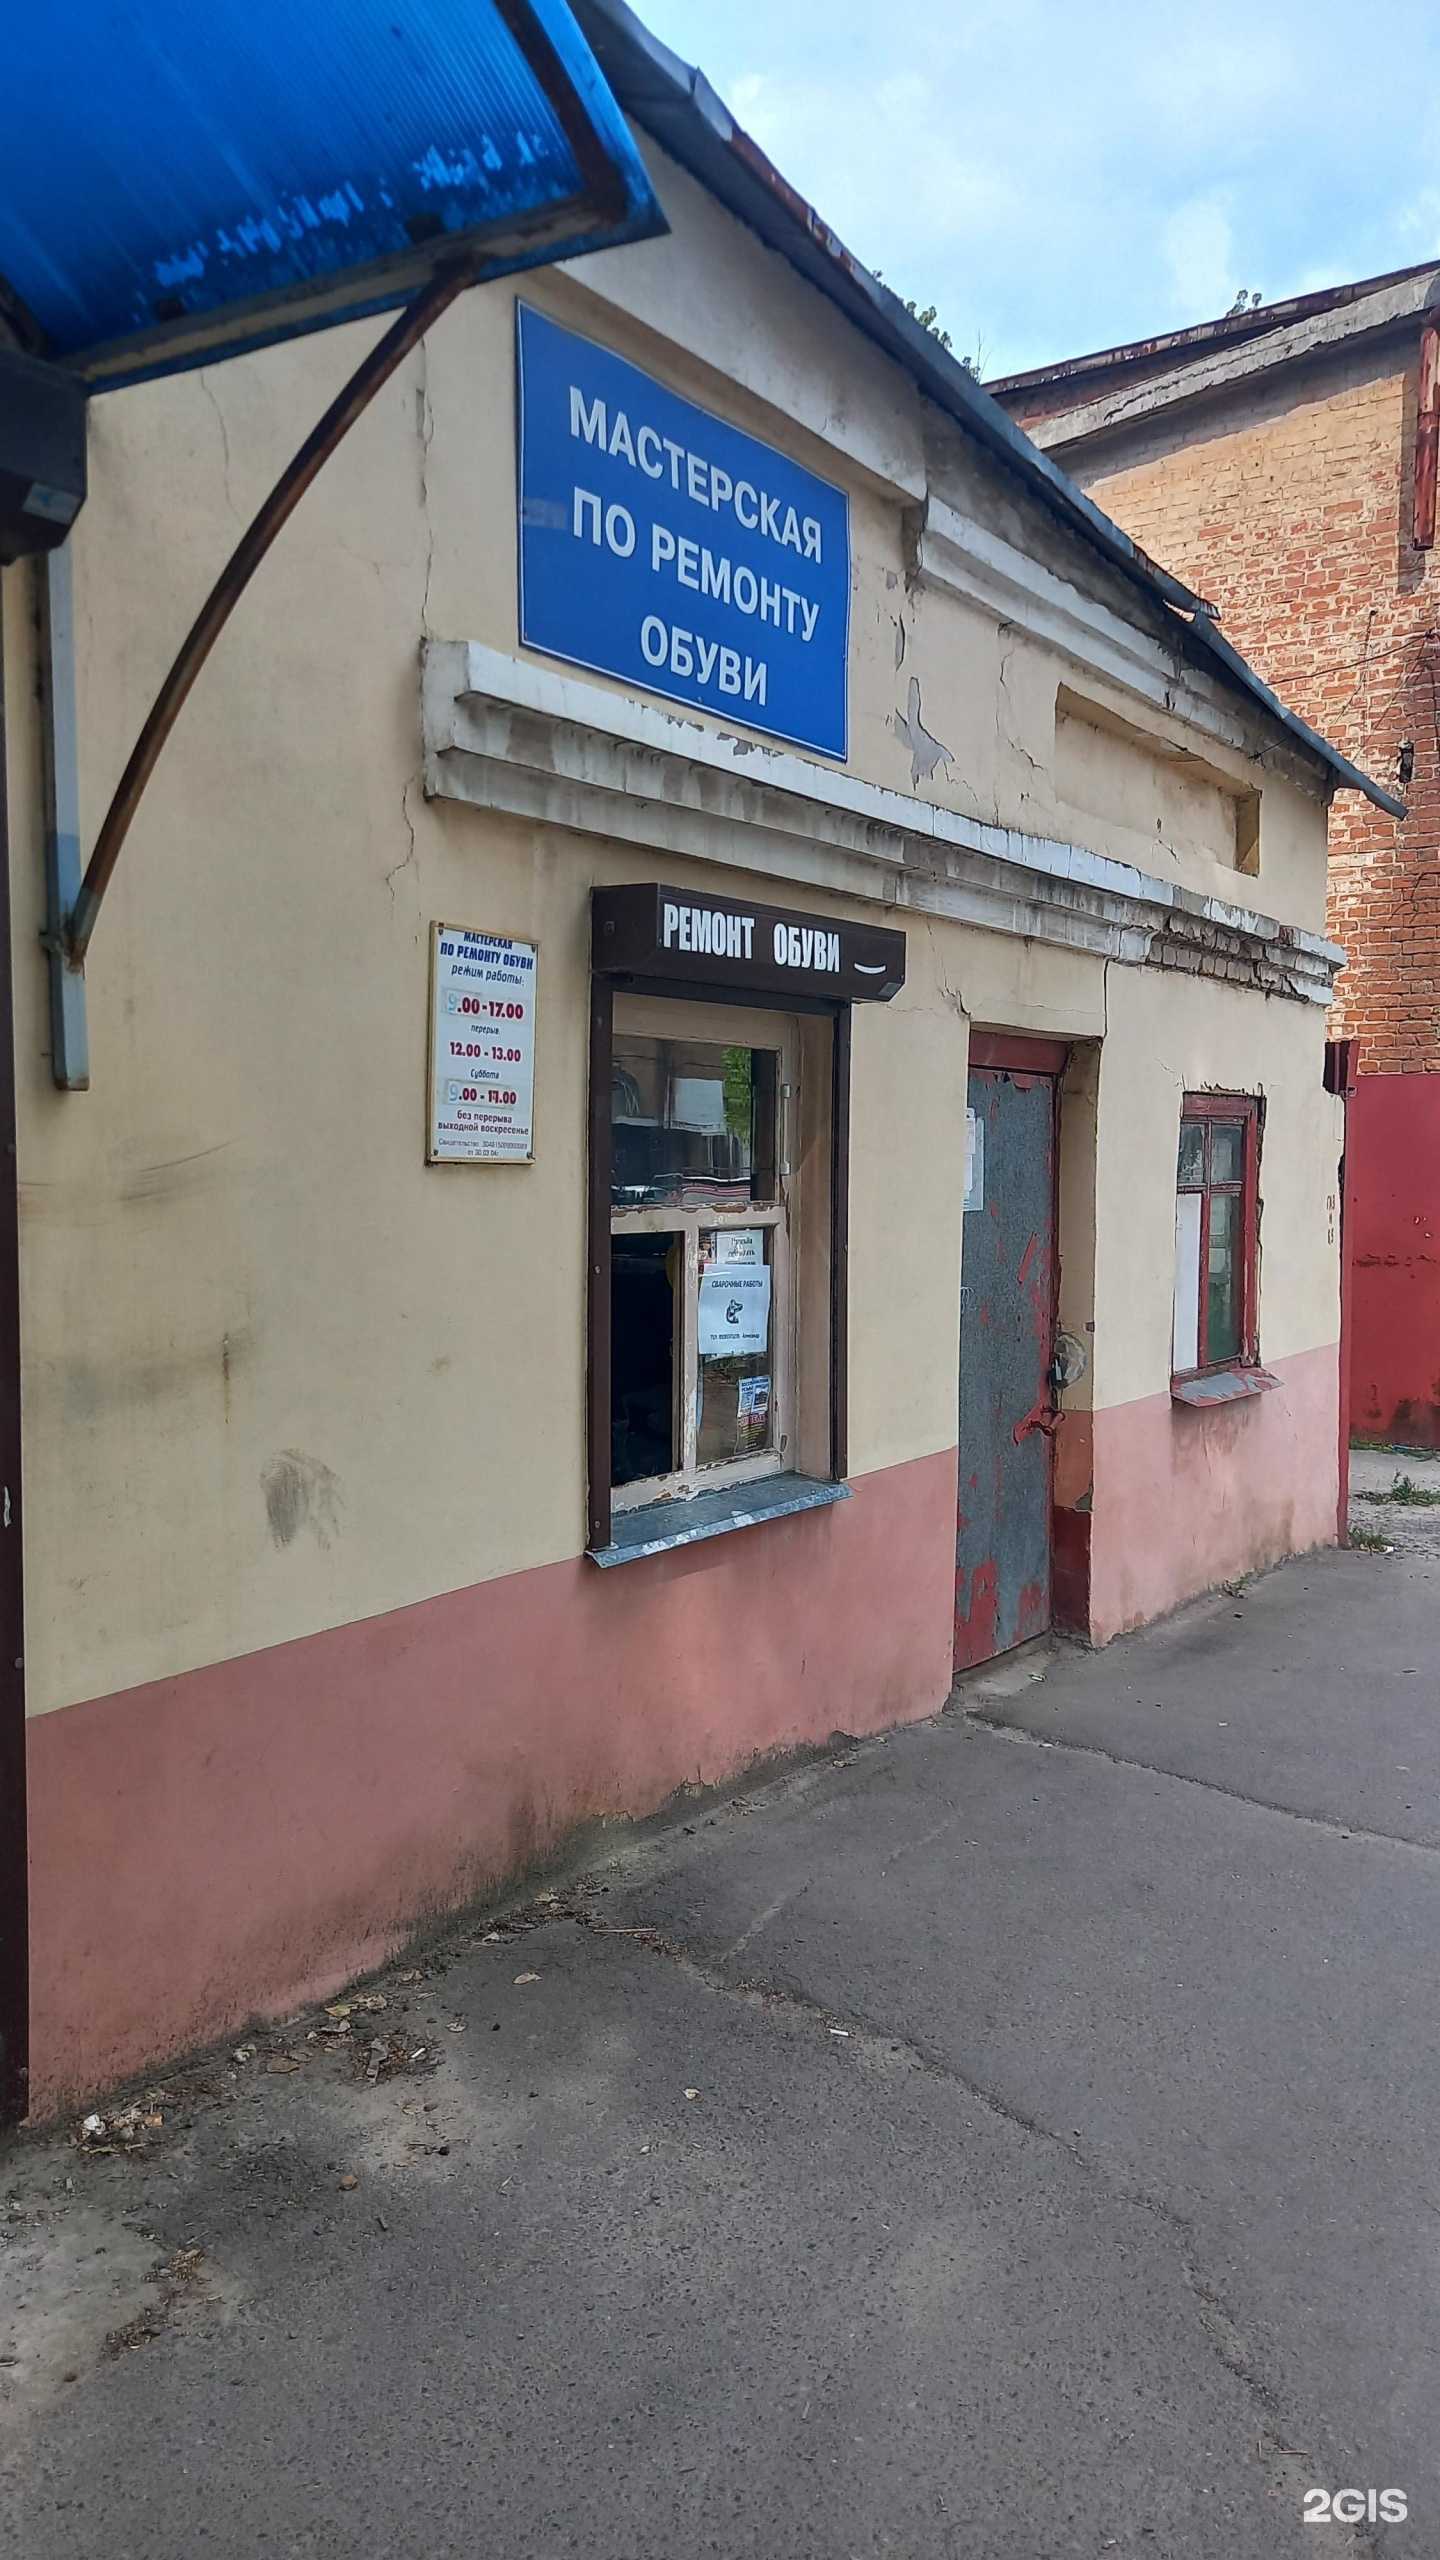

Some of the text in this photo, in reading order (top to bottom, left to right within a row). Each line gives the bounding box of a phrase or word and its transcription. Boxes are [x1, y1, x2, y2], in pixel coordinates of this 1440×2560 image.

[569, 385, 822, 564] МАСТЕРСКАЯ
[572, 486, 820, 642] ПО РЕМОНТУ
[640, 614, 768, 706] ОБУВИ
[463, 931, 513, 950] МАСТЕРСКАЯ
[663, 903, 840, 973] РЕМОНТ ОБУВИ
[440, 942, 533, 970] ПО РЕМОНТУ ОБУВИ
[451, 964, 483, 978] режим
[470, 1024, 499, 1035] перерыв
[450, 1041, 481, 1058] 12.00
[491, 1046, 521, 1062] 13.00
[470, 1068, 500, 1079] Суббота
[457, 1109, 512, 1123] без перерыва
[438, 1122, 529, 1135] выходной воскресенье
